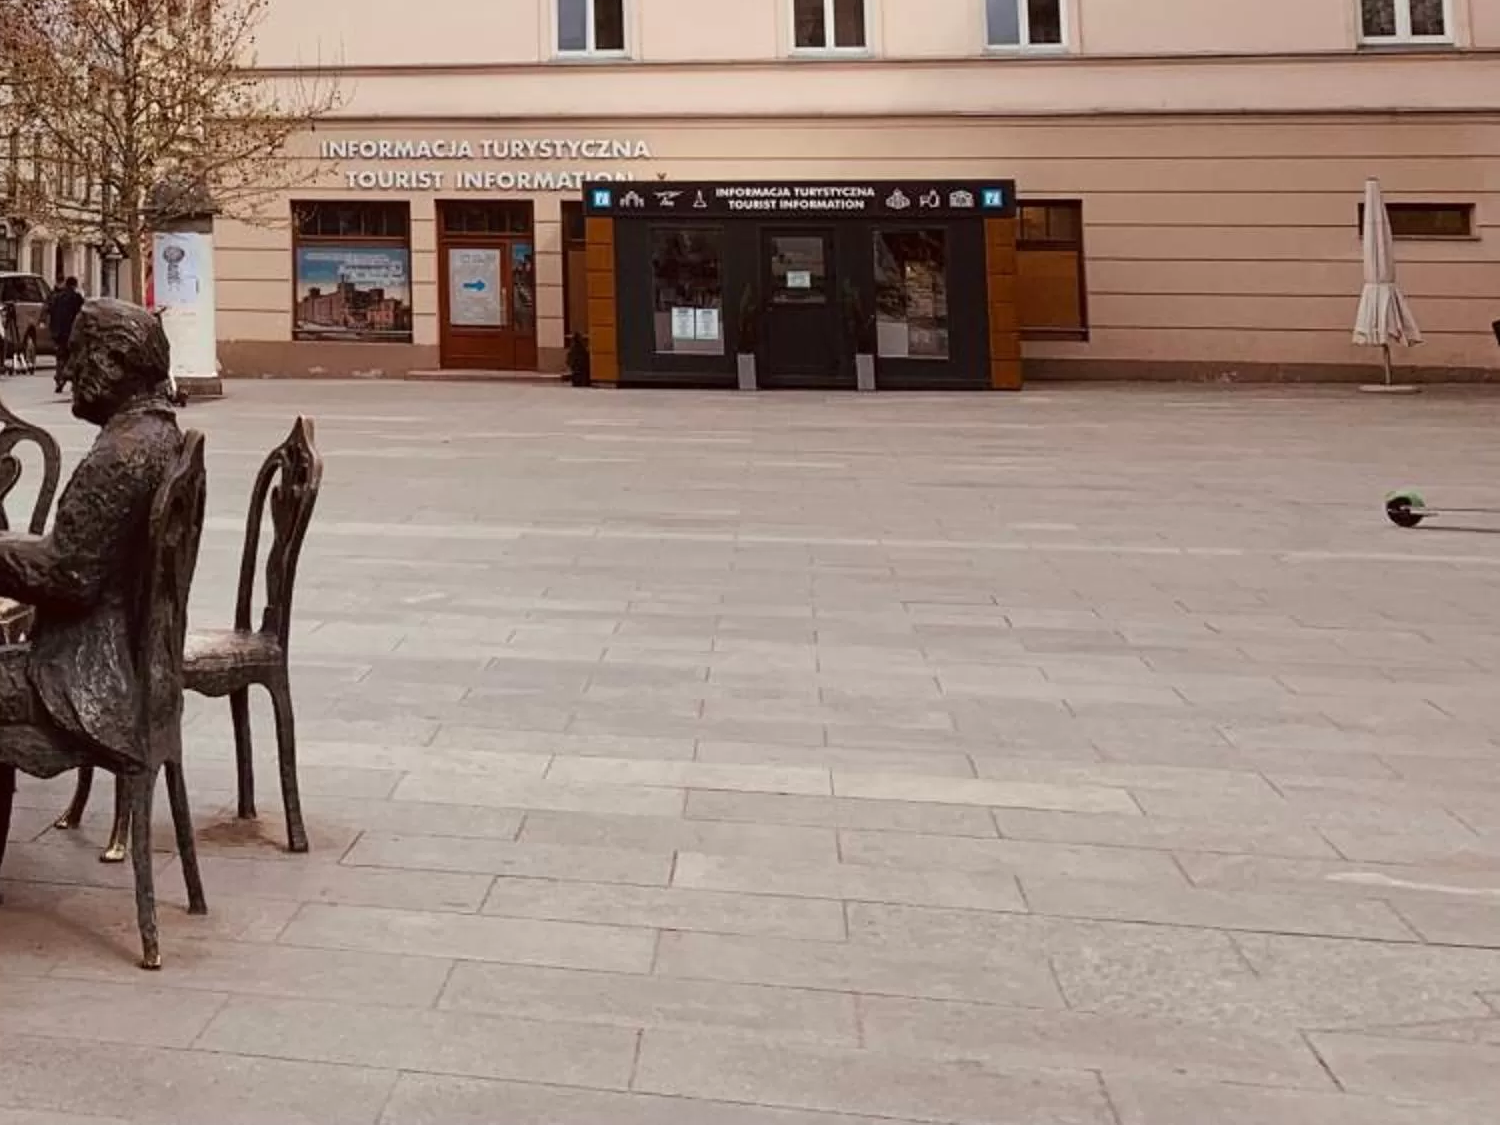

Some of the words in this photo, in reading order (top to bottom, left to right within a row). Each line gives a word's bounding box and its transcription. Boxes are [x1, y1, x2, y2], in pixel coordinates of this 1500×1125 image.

[321, 139, 474, 159] INFORMACJA
[480, 139, 651, 158] TURYSTYCZNA
[345, 171, 444, 189] TOURIST
[715, 187, 791, 198] INFORMACJA
[794, 187, 875, 198] TURYSTYCZNA
[728, 200, 776, 210] TOURIST
[779, 200, 865, 210] INFORMATION
